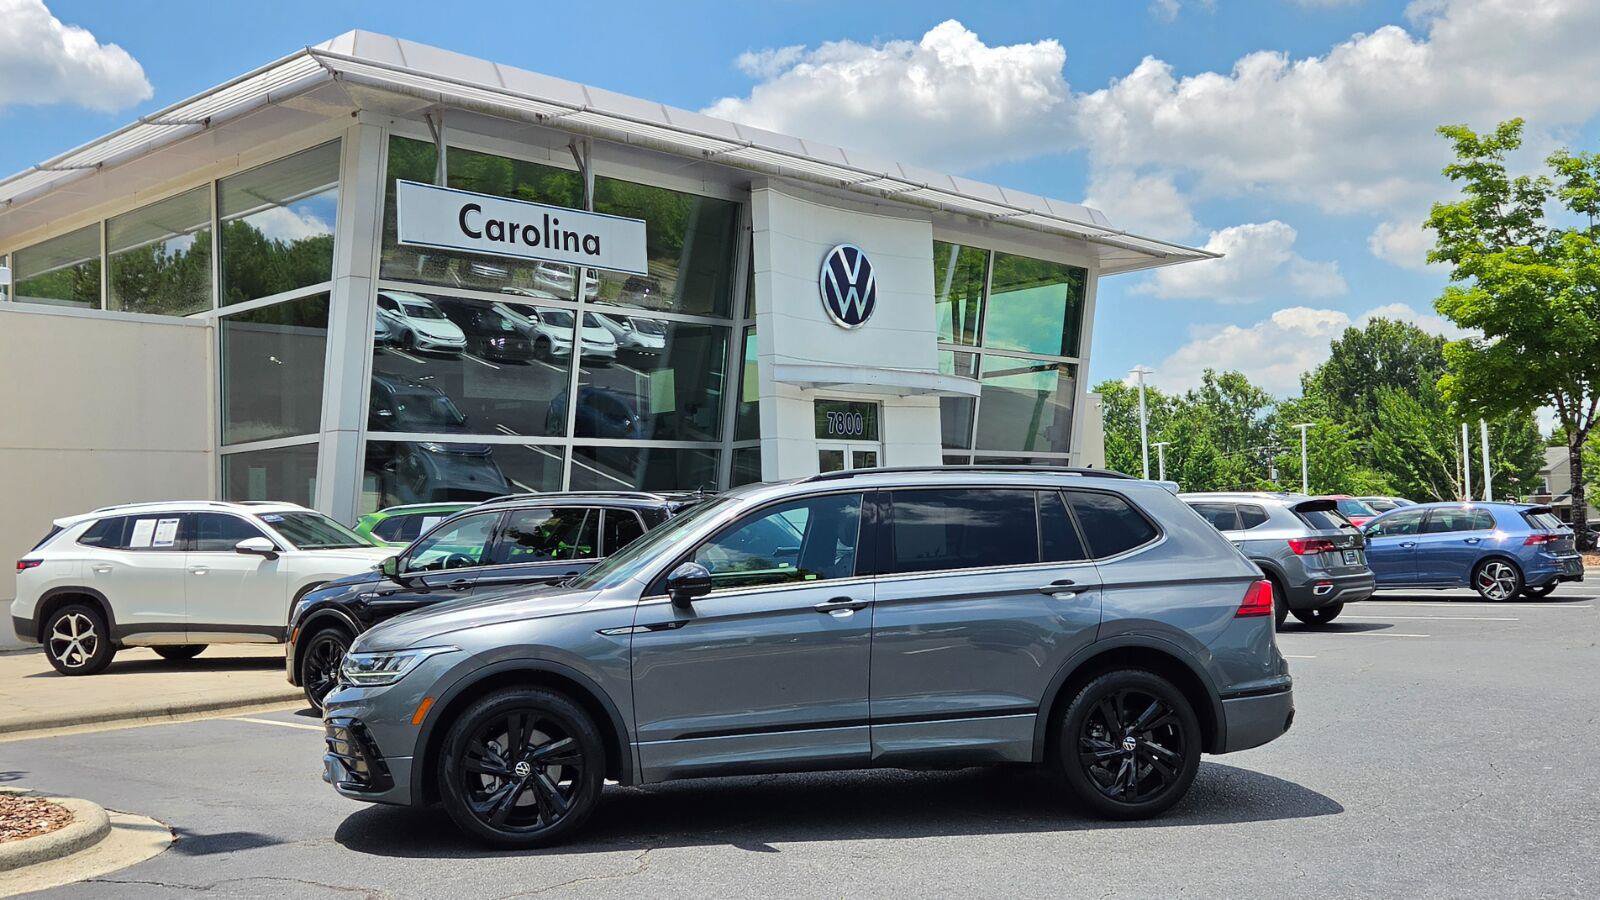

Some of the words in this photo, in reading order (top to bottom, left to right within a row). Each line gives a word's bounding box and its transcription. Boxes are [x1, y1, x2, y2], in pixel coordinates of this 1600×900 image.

[458, 203, 601, 256] Carolina
[821, 245, 877, 326] VW
[827, 412, 863, 435] 7800
